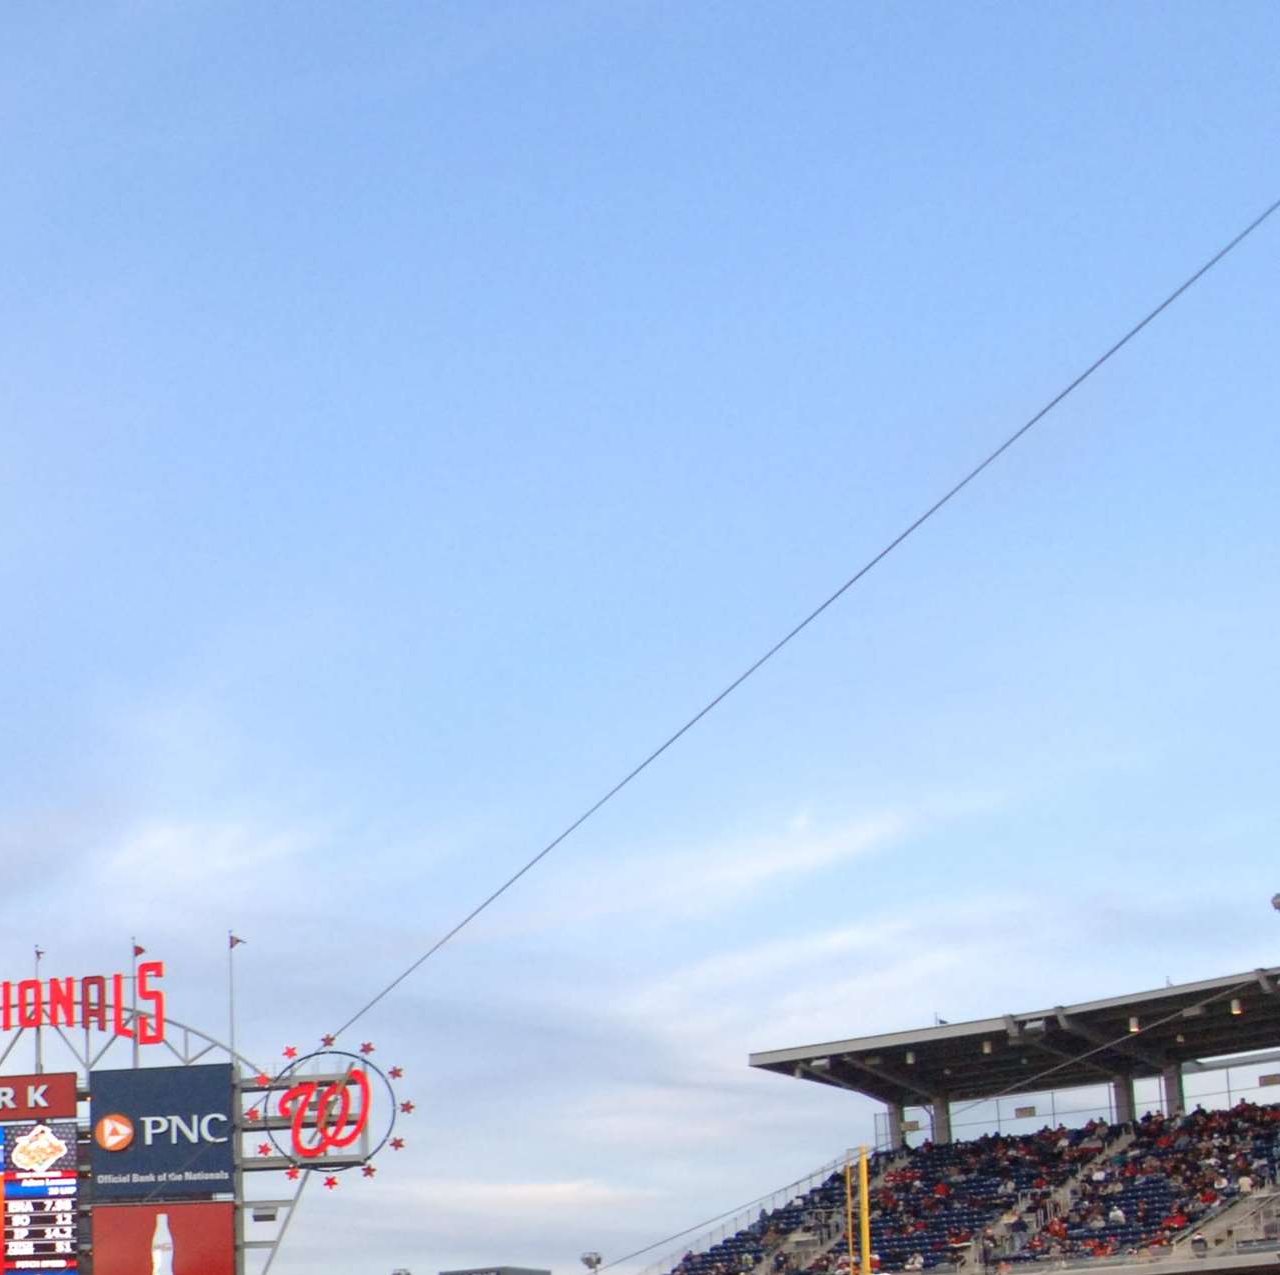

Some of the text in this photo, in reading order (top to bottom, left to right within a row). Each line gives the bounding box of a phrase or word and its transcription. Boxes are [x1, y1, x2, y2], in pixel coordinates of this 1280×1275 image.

[140, 1113, 228, 1145] PNC
[97, 1174, 130, 1184] Official
[132, 1173, 155, 1183] Bank
[157, 1172, 167, 1182] of
[184, 1170, 229, 1180] Nationals
